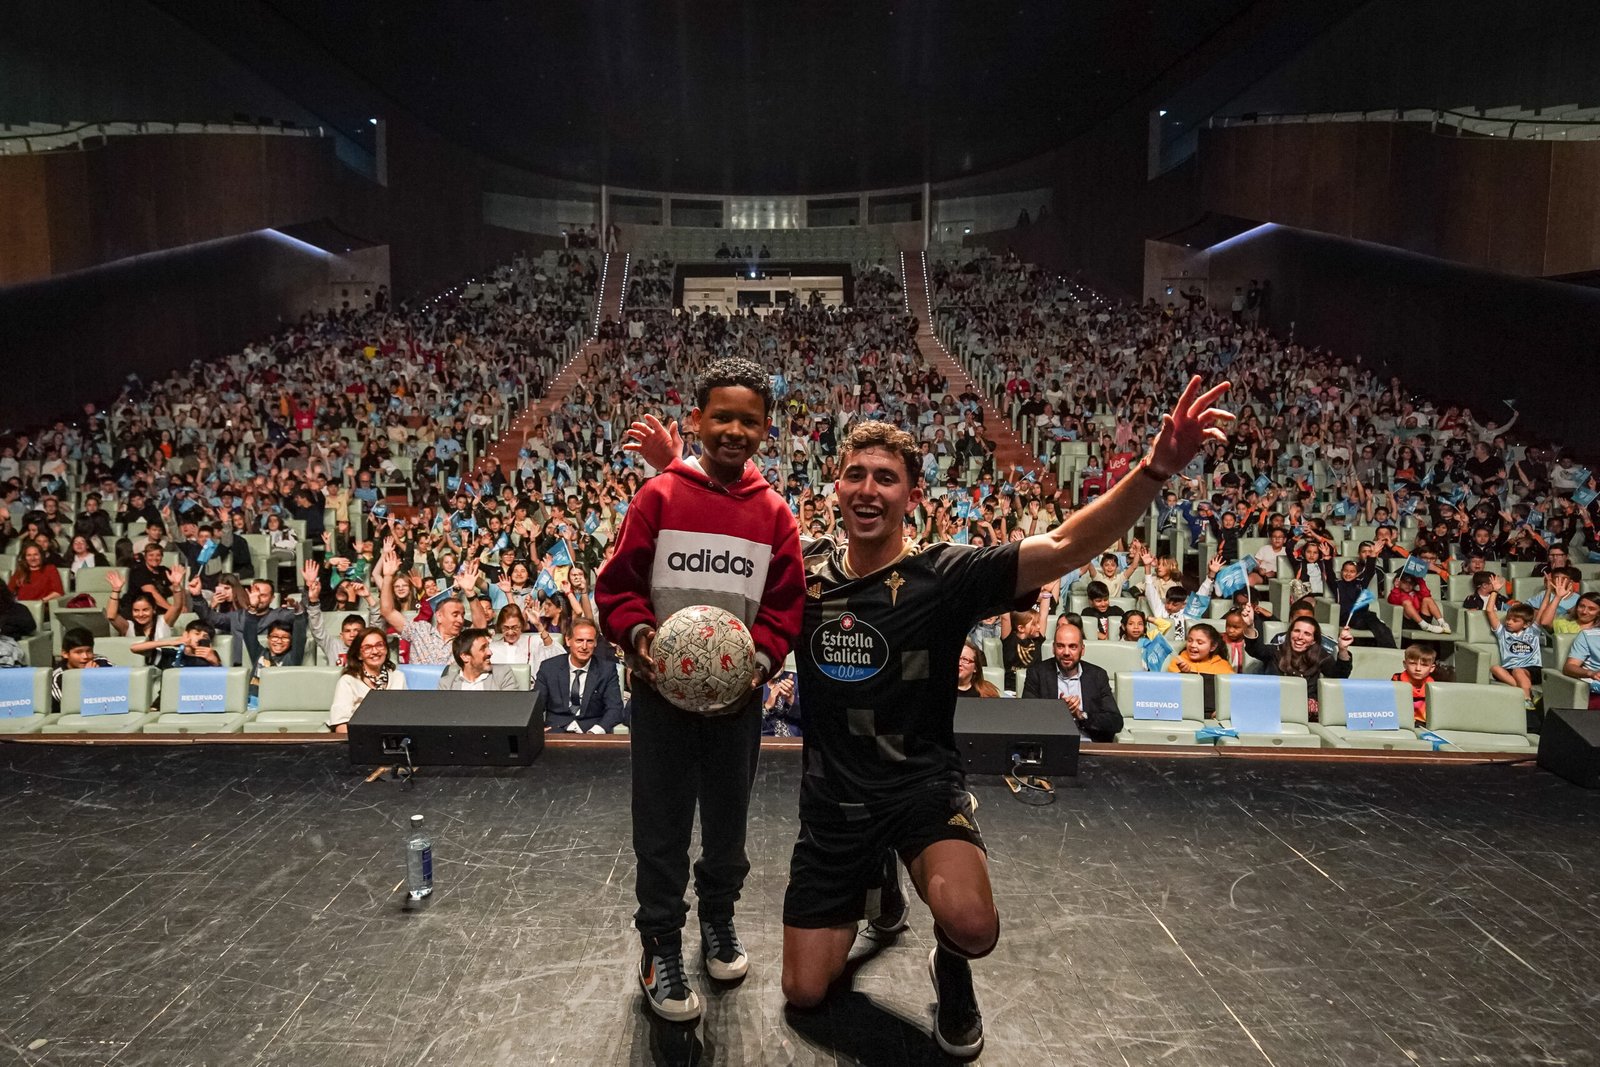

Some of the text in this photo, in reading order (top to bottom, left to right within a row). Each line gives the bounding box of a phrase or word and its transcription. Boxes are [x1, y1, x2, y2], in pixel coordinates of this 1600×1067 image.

[1109, 457, 1127, 470] Lee
[667, 548, 755, 578] adidas
[821, 630, 874, 649] Estrella
[823, 646, 872, 665] Galicia
[83, 695, 127, 704] RESERVADO
[181, 694, 224, 702] RESERVADO
[1135, 700, 1179, 709] RESERVADO
[1347, 711, 1394, 719] RESERVADO
